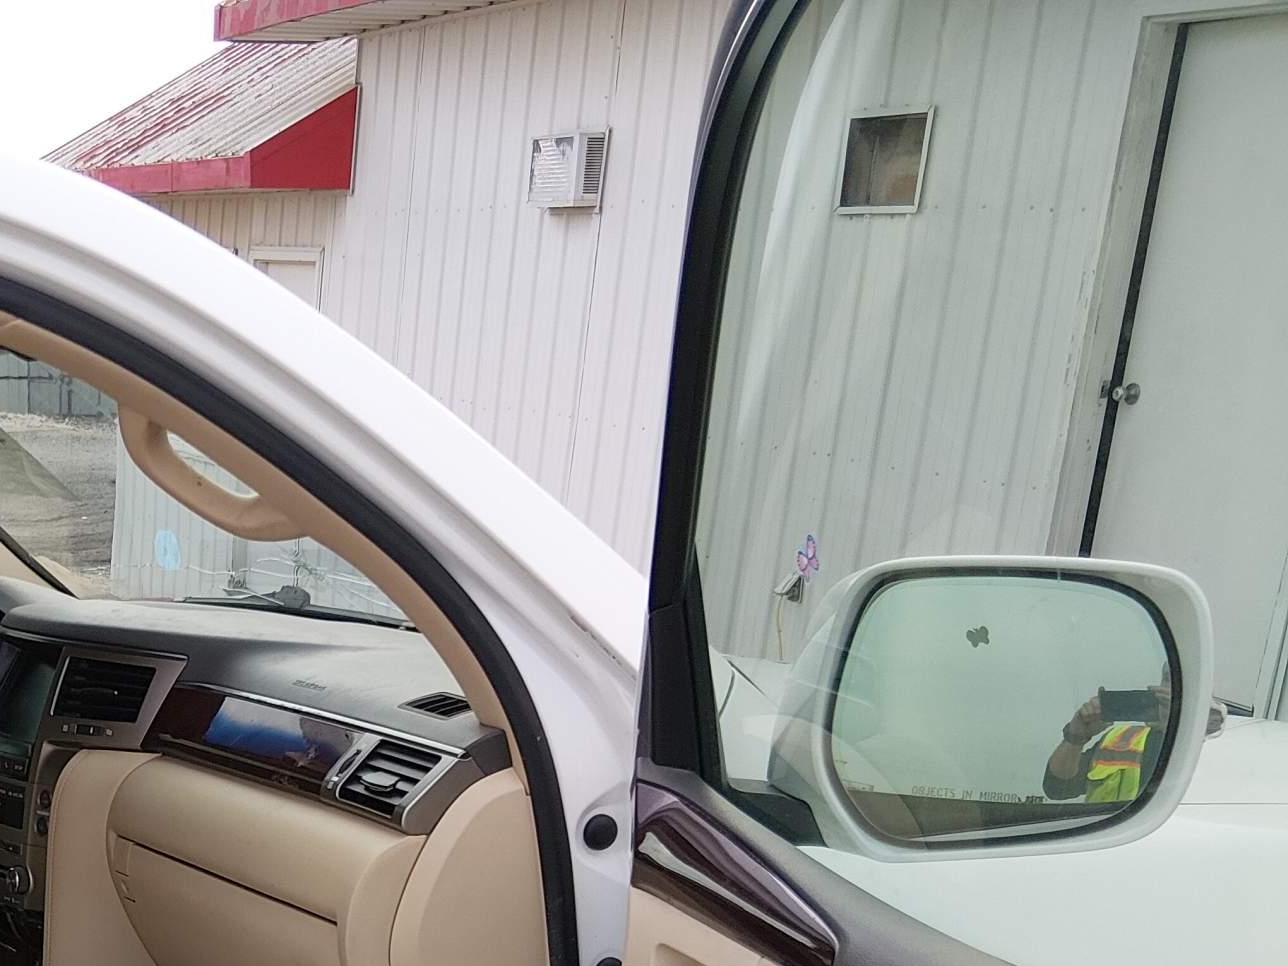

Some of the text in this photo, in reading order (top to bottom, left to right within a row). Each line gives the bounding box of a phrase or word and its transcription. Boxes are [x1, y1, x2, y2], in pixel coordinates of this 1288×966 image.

[911, 785, 955, 798] OBJECTS
[962, 789, 973, 800] IN
[979, 791, 1018, 803] MIRROR
